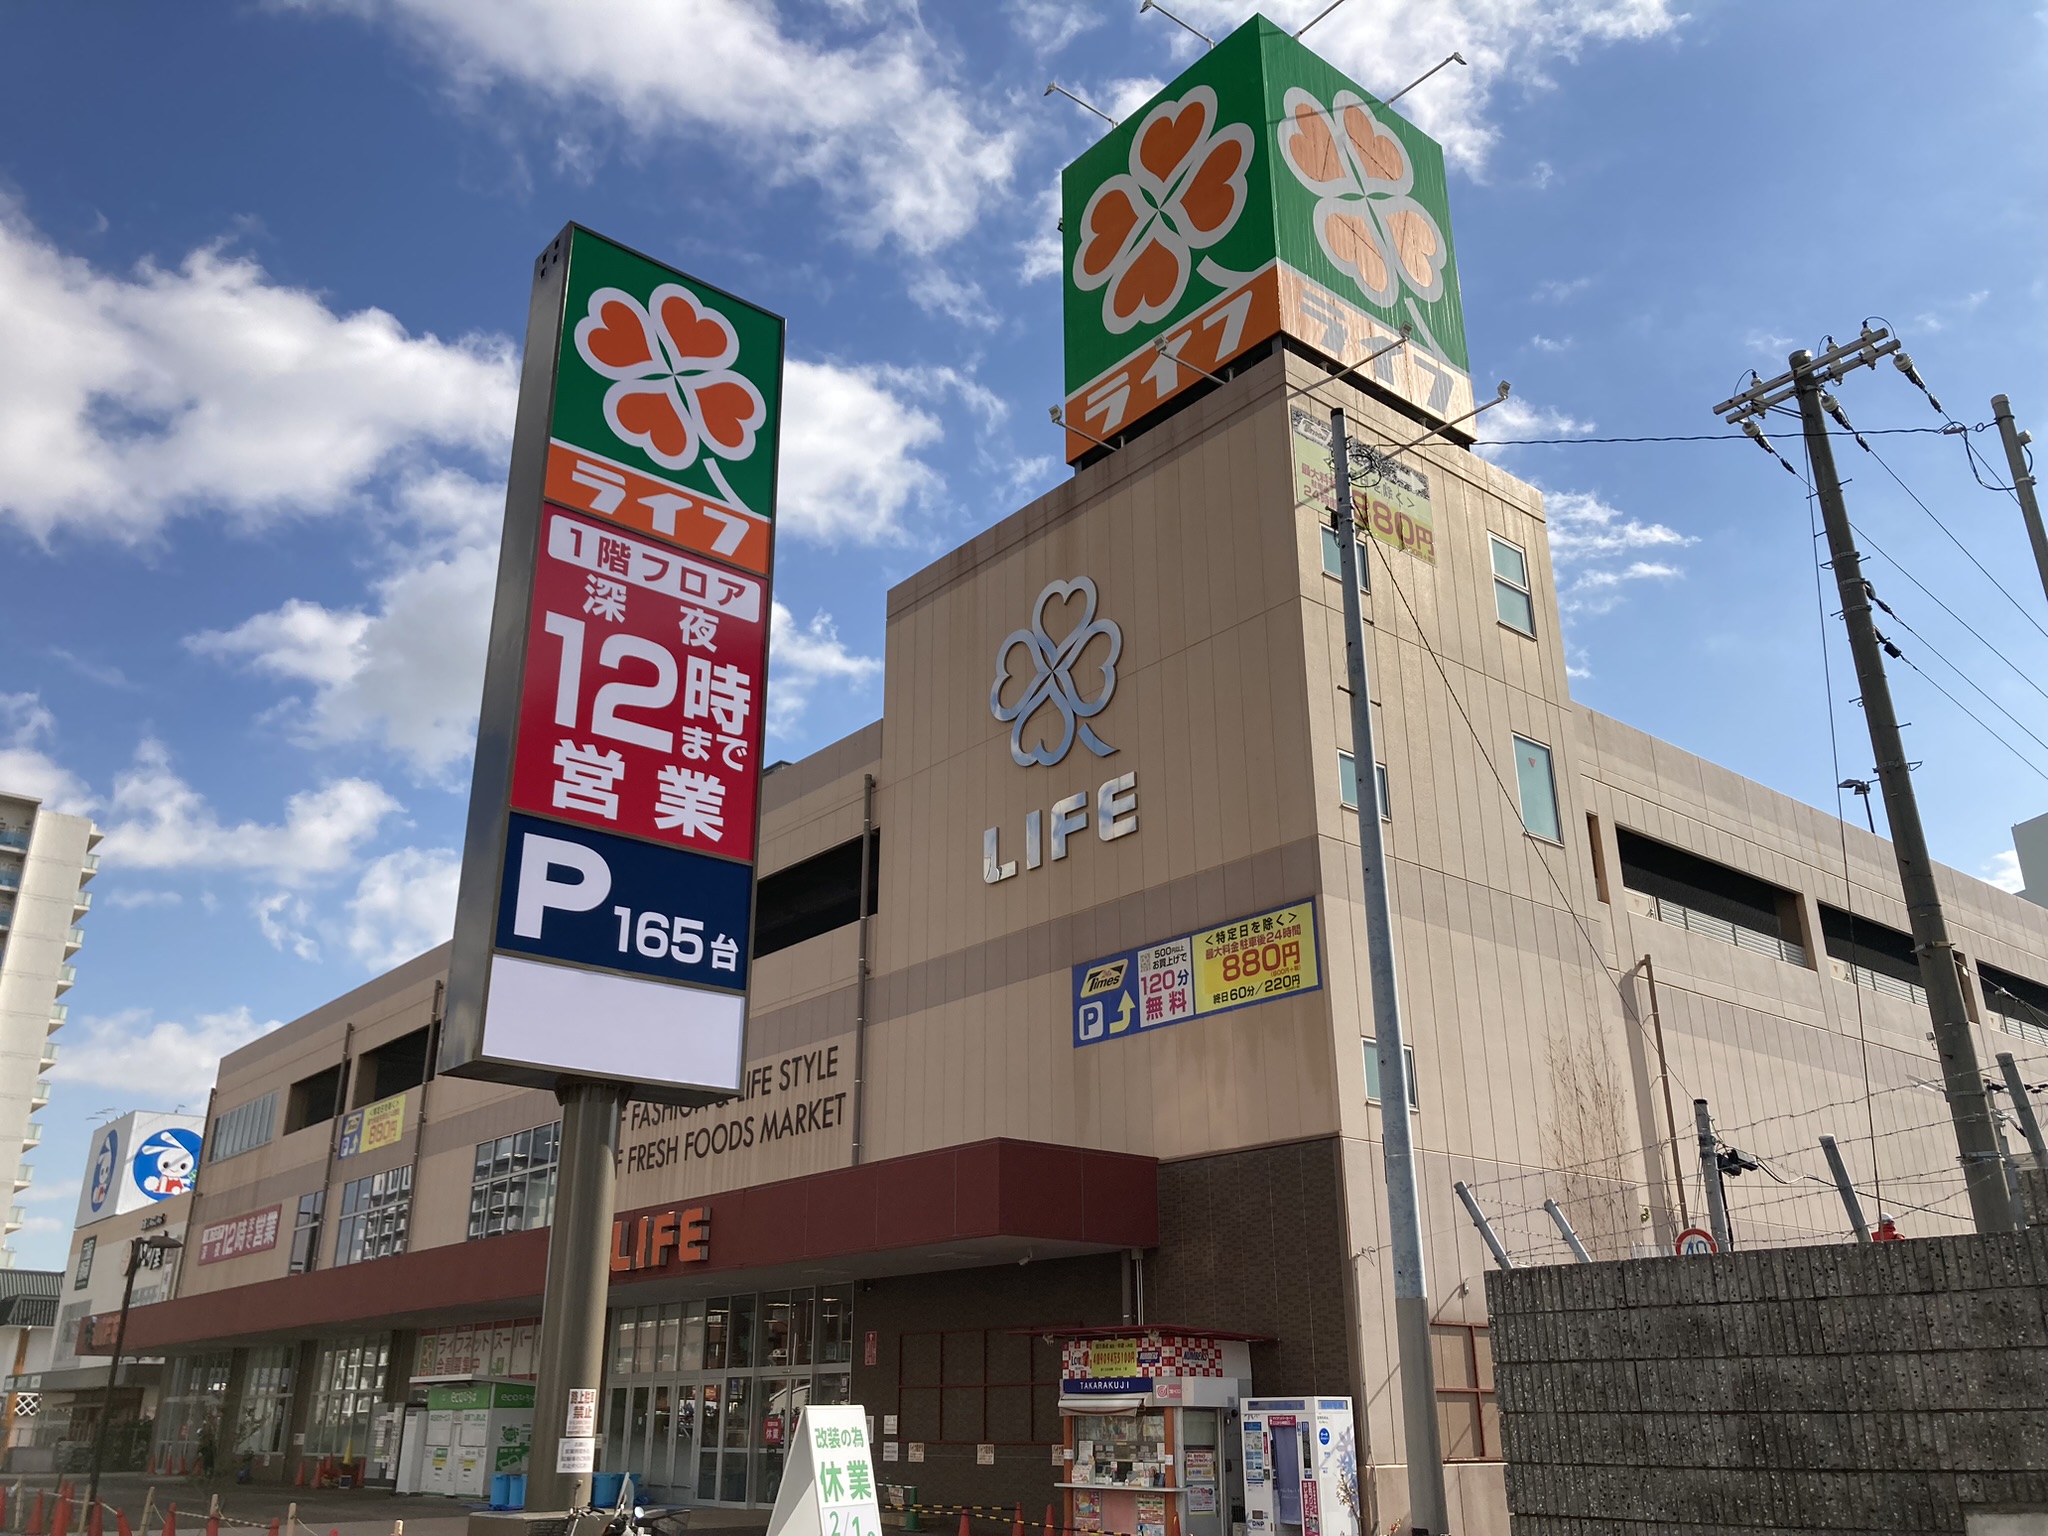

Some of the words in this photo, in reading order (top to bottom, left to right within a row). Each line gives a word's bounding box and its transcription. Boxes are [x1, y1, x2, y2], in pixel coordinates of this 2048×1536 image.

[1085, 291, 1254, 434] ライフ
[1299, 288, 1454, 415] ライフ
[572, 459, 750, 557] ライフ
[571, 527, 746, 605] 1階フロア
[552, 738, 726, 842] 営業
[983, 771, 1139, 884] LIFE
[513, 832, 612, 940] P
[613, 905, 740, 973] 165台
[1089, 976, 1120, 992] Times
[1141, 969, 1189, 995] 120分
[1222, 940, 1301, 982] 880円
[1083, 1007, 1098, 1036] P
[1145, 989, 1187, 1020] 無料
[738, 1065, 773, 1102] IFE
[779, 1046, 838, 1091] STYLE
[628, 1136, 678, 1174] FRESH
[684, 1116, 754, 1161] FOODS
[760, 1092, 846, 1144] MARKET
[610, 1207, 711, 1272] LIFE
[1080, 1381, 1130, 1390] TAKARAKUJI
[815, 1427, 865, 1449] 改装の為
[820, 1460, 872, 1503] 休業
[829, 1511, 876, 1536] 2/1
